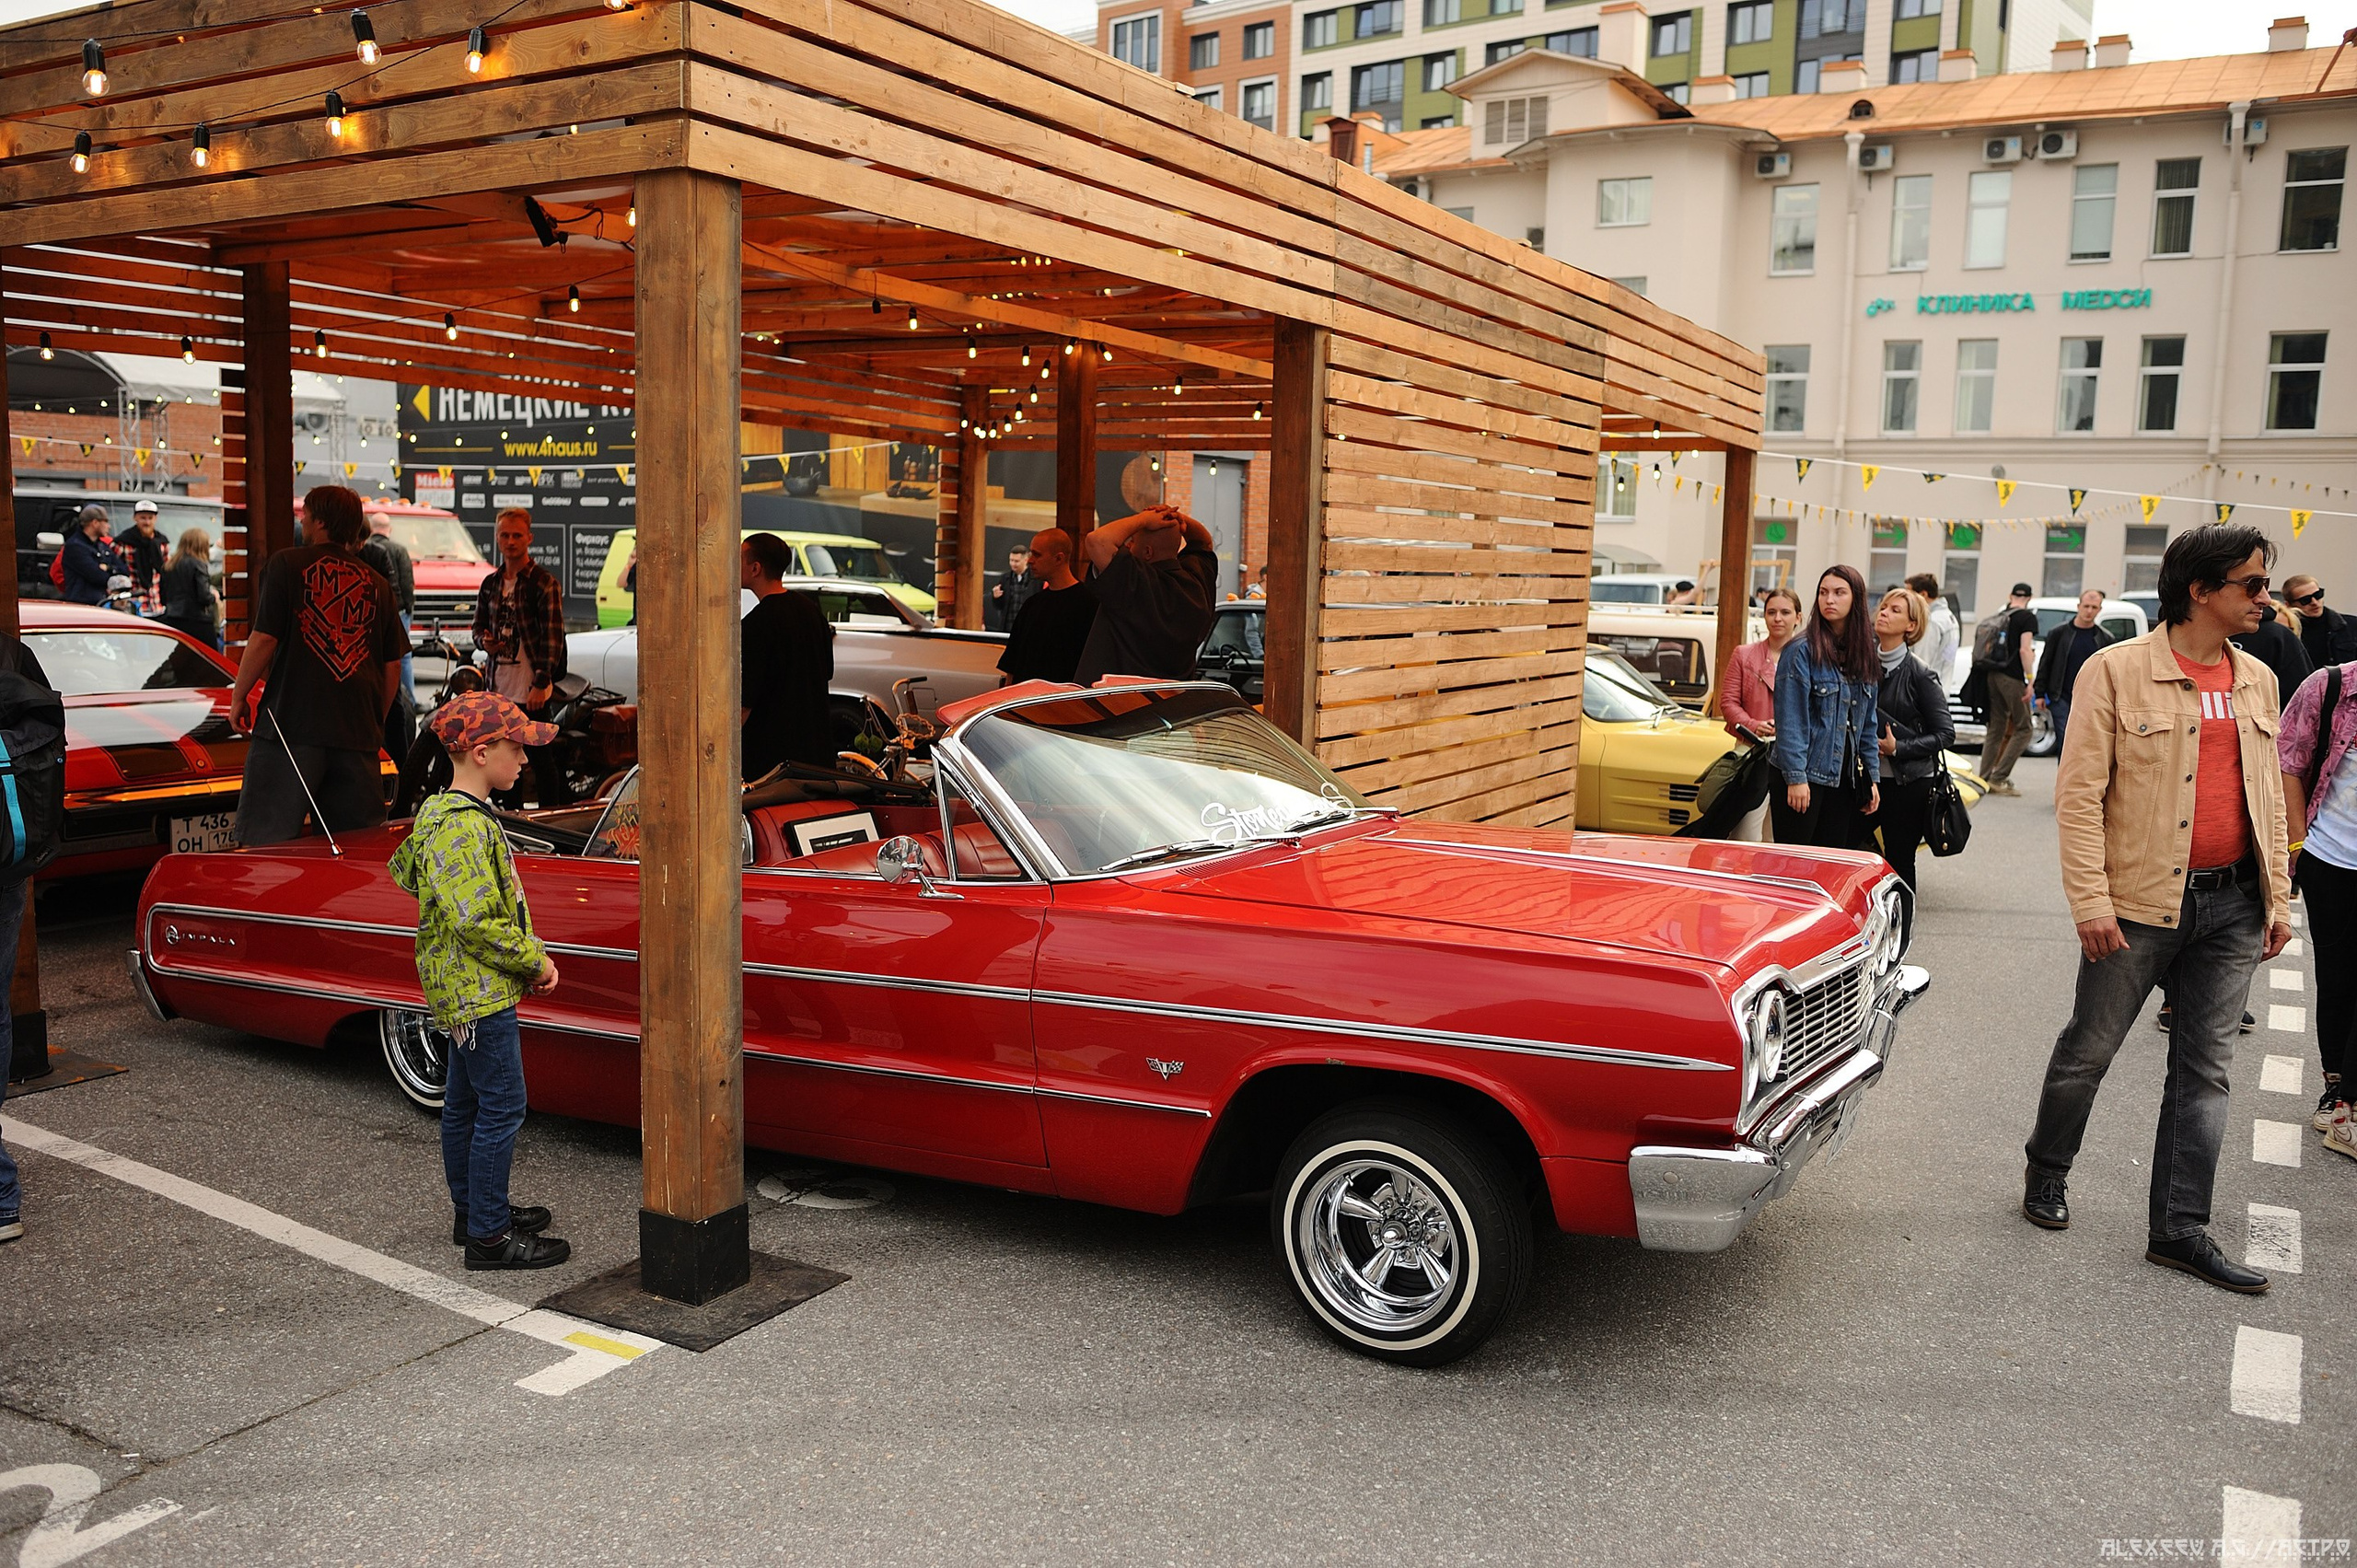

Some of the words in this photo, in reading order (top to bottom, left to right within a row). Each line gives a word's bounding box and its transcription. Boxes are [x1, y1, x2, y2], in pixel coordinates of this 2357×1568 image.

[1917, 292, 2036, 315] КЛИНИКА
[438, 386, 590, 428] НЕМЕЦКИЕ
[182, 818, 192, 833] Т
[200, 813, 229, 830] 436
[177, 836, 203, 854] ОН
